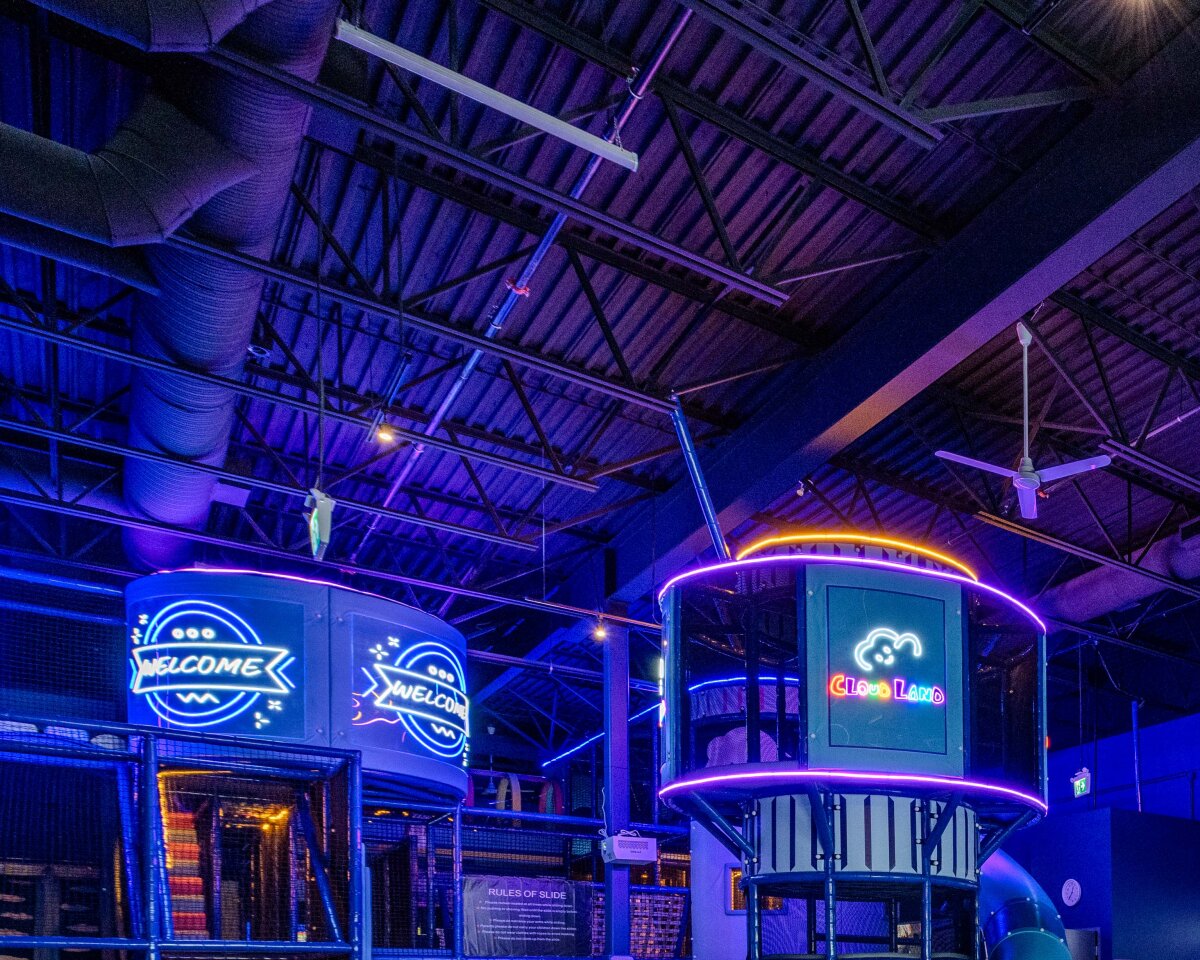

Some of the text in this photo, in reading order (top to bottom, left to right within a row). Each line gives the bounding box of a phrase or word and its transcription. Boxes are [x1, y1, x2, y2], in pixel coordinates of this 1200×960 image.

[141, 655, 265, 677] WELCOME
[829, 675, 945, 704] CLOUD LAND
[488, 888, 567, 900] RULES OF SLIDE
